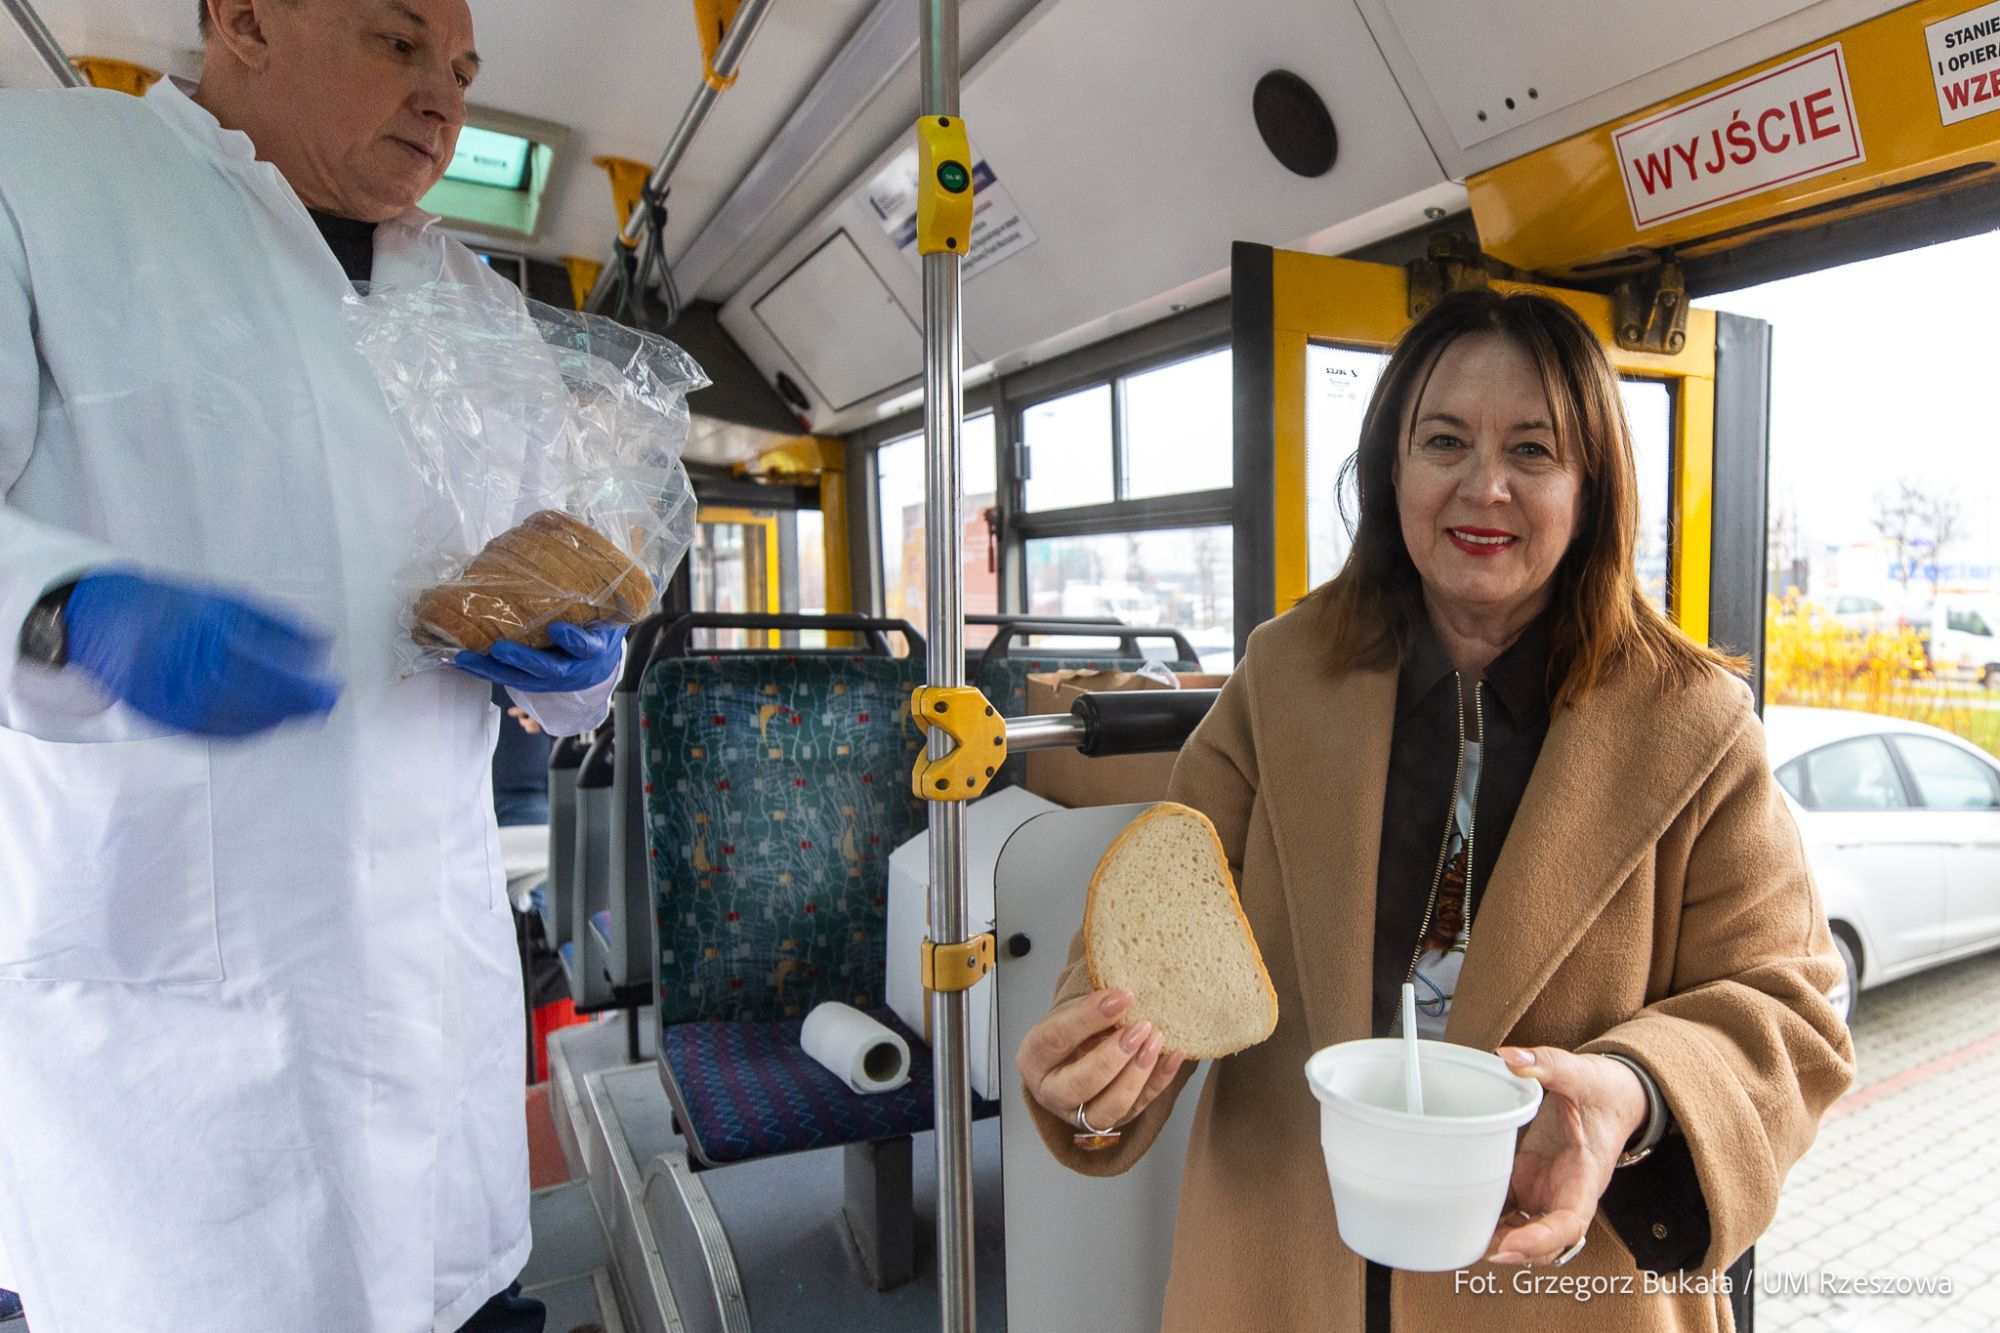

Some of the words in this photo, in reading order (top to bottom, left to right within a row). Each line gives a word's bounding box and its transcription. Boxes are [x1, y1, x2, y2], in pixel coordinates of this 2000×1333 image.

[1938, 62, 1944, 76] I
[1948, 43, 2000, 72] OPIER
[1633, 88, 1841, 195] WYJŚCIE
